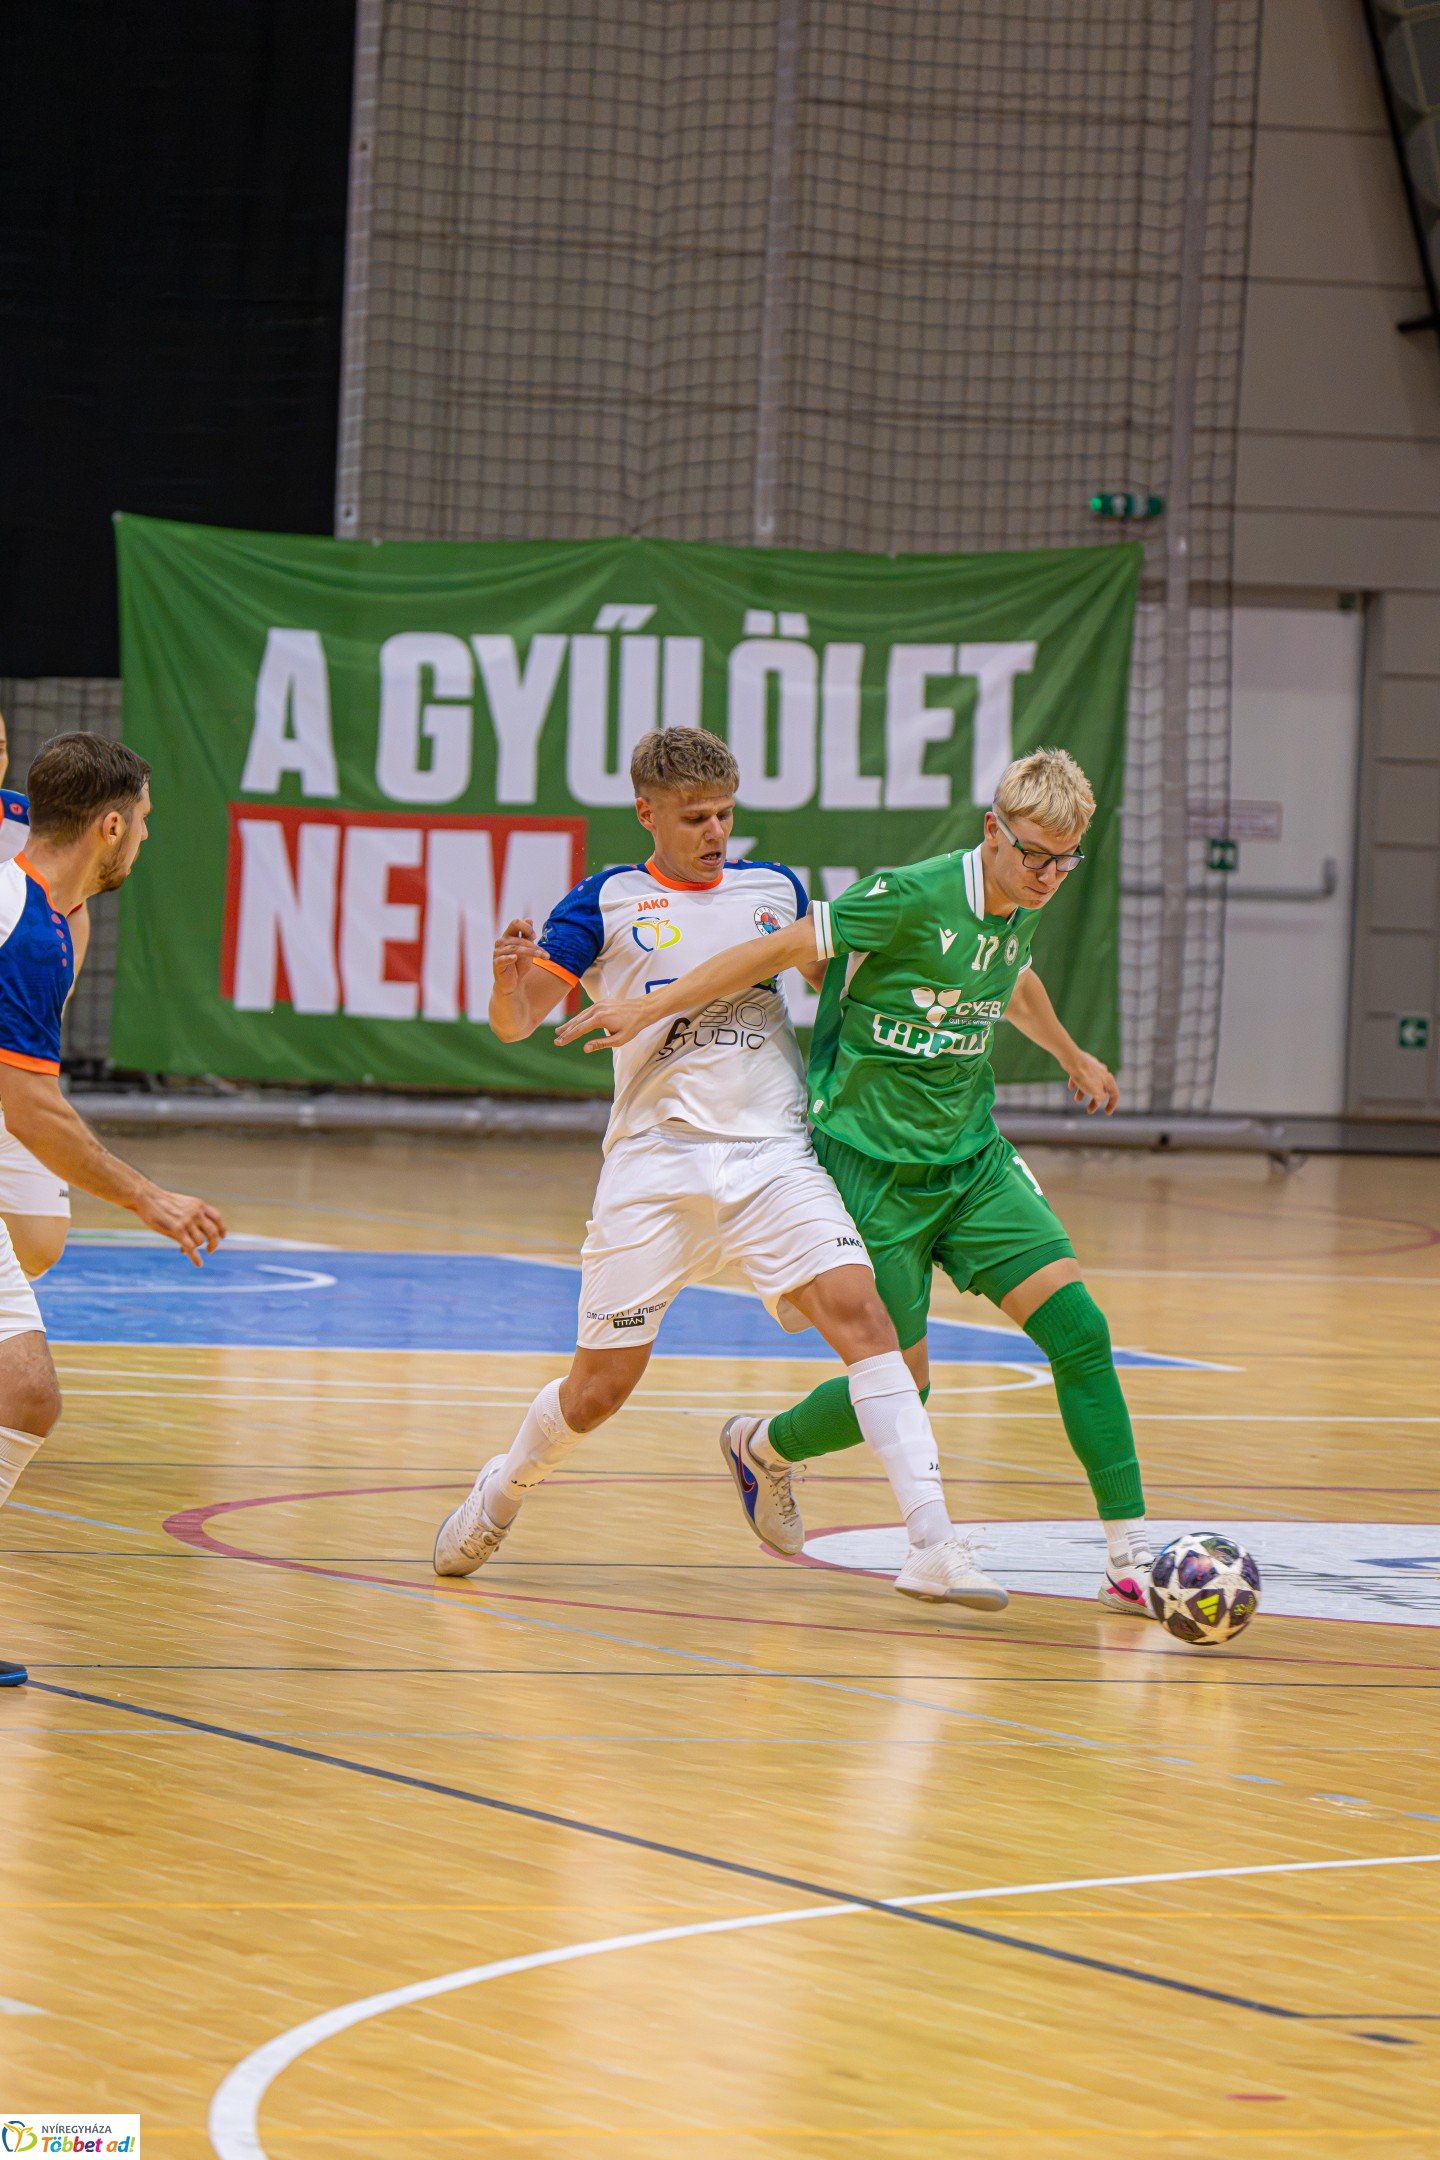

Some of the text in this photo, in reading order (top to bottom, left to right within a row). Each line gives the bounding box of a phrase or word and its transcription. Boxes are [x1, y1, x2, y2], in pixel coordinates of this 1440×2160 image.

[240, 627, 340, 797] A
[233, 818, 574, 1025] NEM
[637, 898, 669, 912] JAKO
[971, 933, 999, 971] 17
[656, 1028, 766, 1062] STUDIO
